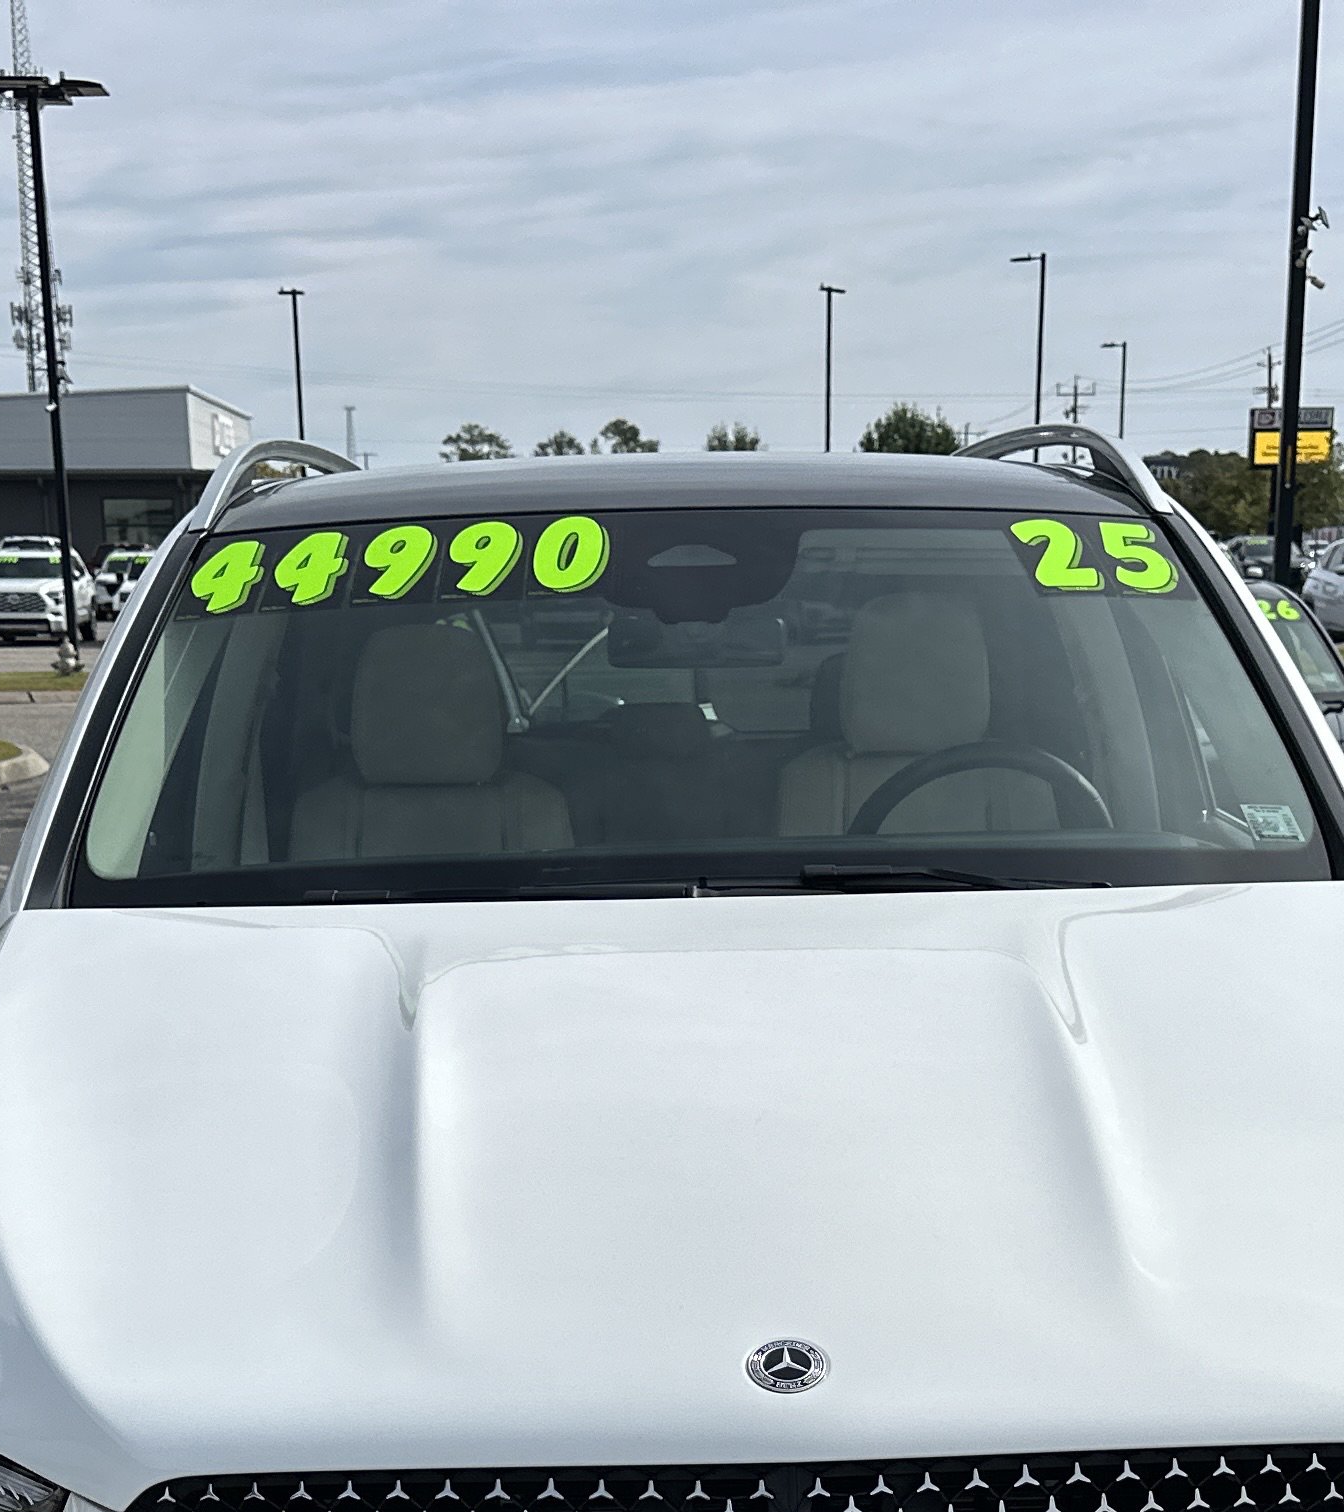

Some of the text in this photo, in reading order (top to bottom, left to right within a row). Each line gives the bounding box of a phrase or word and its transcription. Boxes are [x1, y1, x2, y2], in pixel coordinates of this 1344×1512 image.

[191, 516, 1179, 614] 44990 25
[1256, 600, 1300, 621] 26
